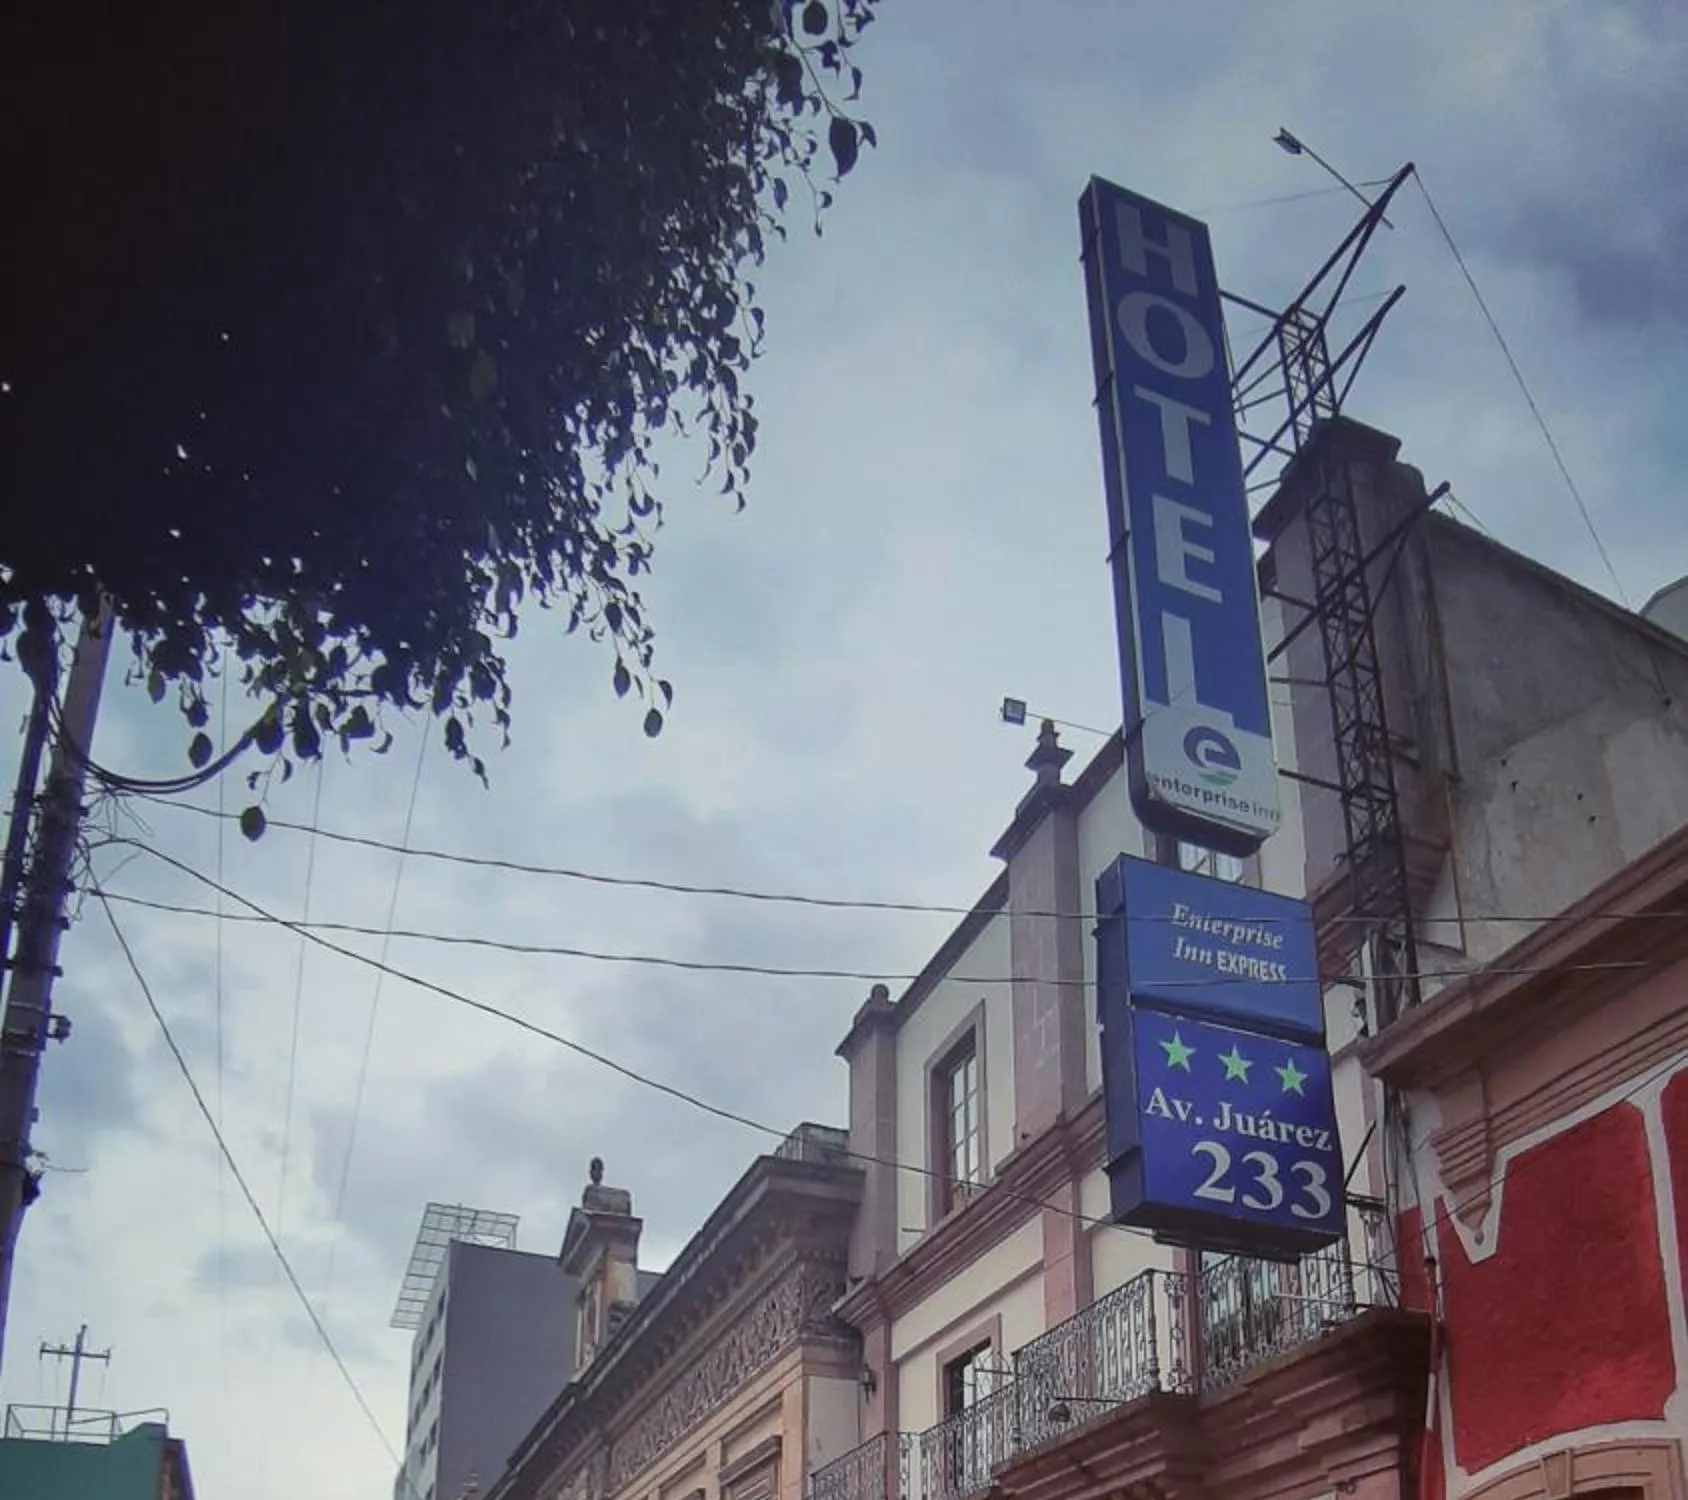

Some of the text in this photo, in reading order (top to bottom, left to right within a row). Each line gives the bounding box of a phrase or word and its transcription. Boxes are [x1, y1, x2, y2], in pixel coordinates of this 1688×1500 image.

[1115, 205, 1234, 727] HOTEL
[1171, 902, 1284, 950] Enterprise
[1173, 936, 1288, 985] Inn EXPRESS
[1145, 1087, 1333, 1152] Av. Juárez
[1191, 1140, 1332, 1219] 233
